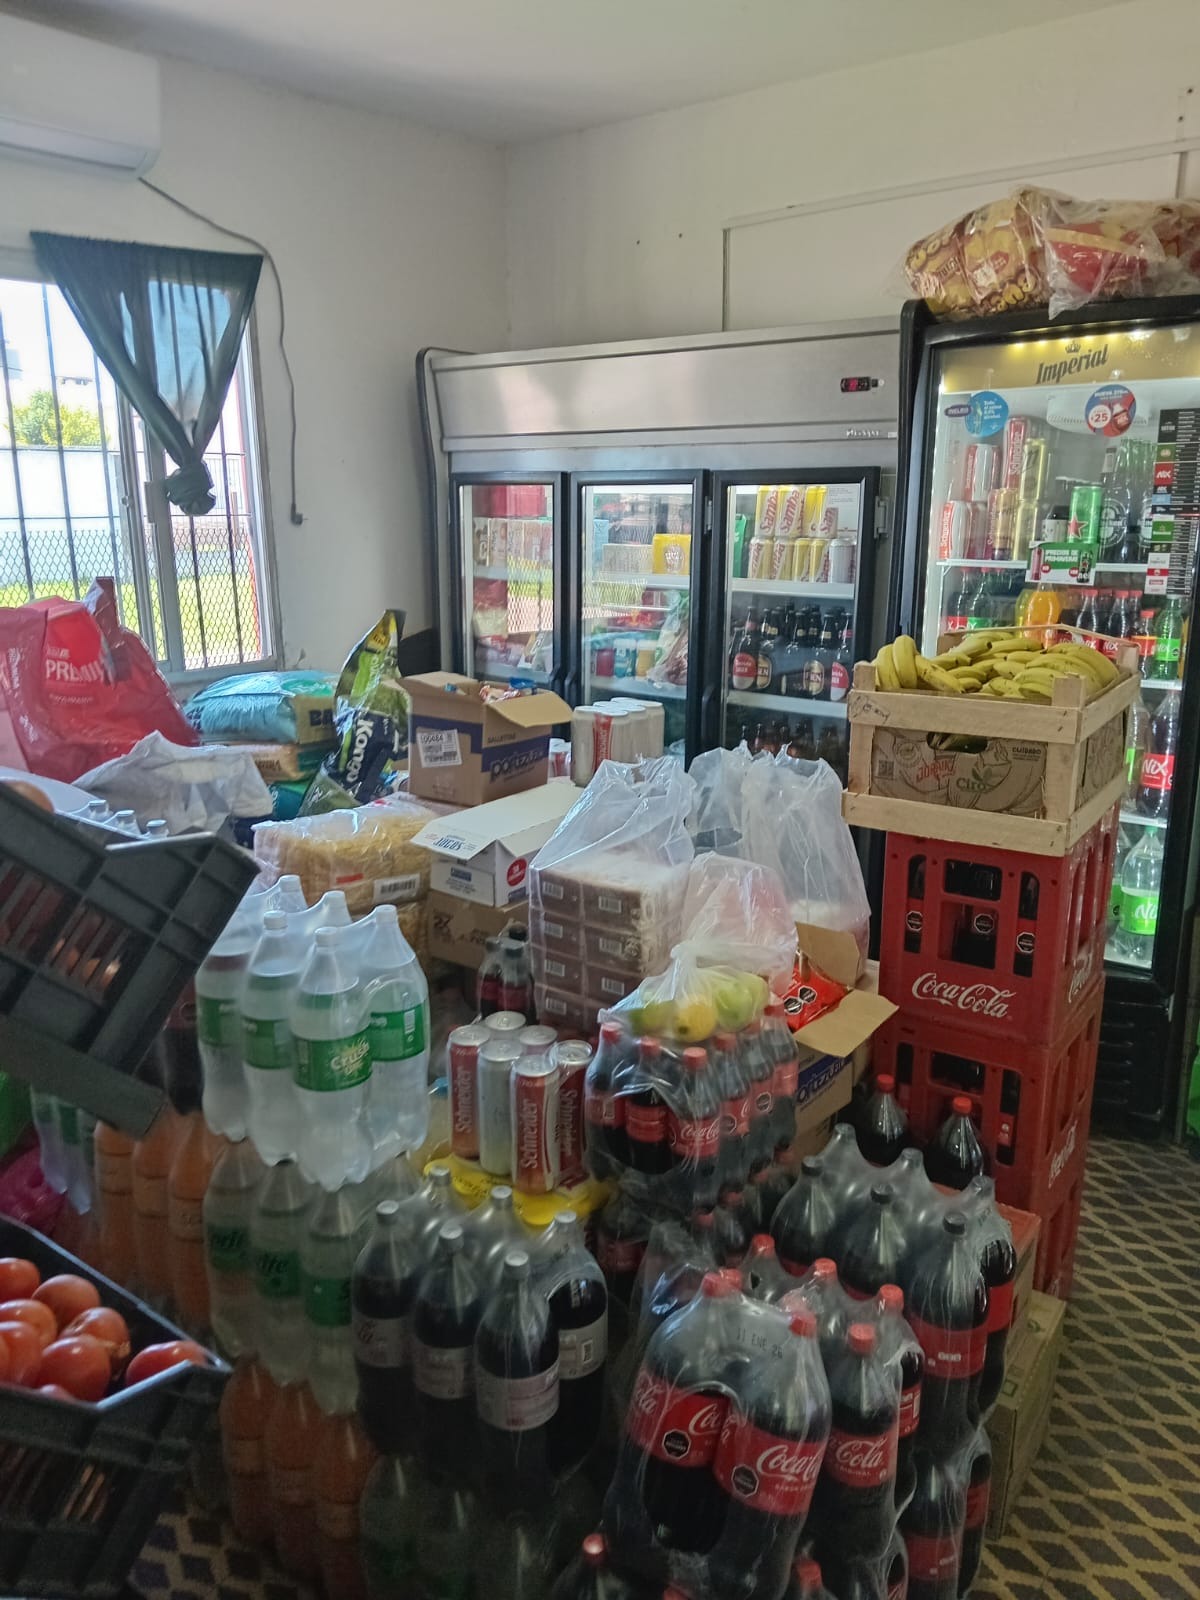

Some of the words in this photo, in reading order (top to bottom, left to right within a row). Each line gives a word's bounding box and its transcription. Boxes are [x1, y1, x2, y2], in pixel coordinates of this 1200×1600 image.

[1035, 344, 1109, 385] Imperial
[761, 490, 779, 533] Samba
[780, 489, 801, 533] Samba
[346, 718, 374, 783] Kongo
[956, 776, 985, 793] Ciro
[912, 973, 1017, 1019] Coca-Cola
[331, 1037, 370, 1072] Crush
[520, 1098, 538, 1169] Schneider
